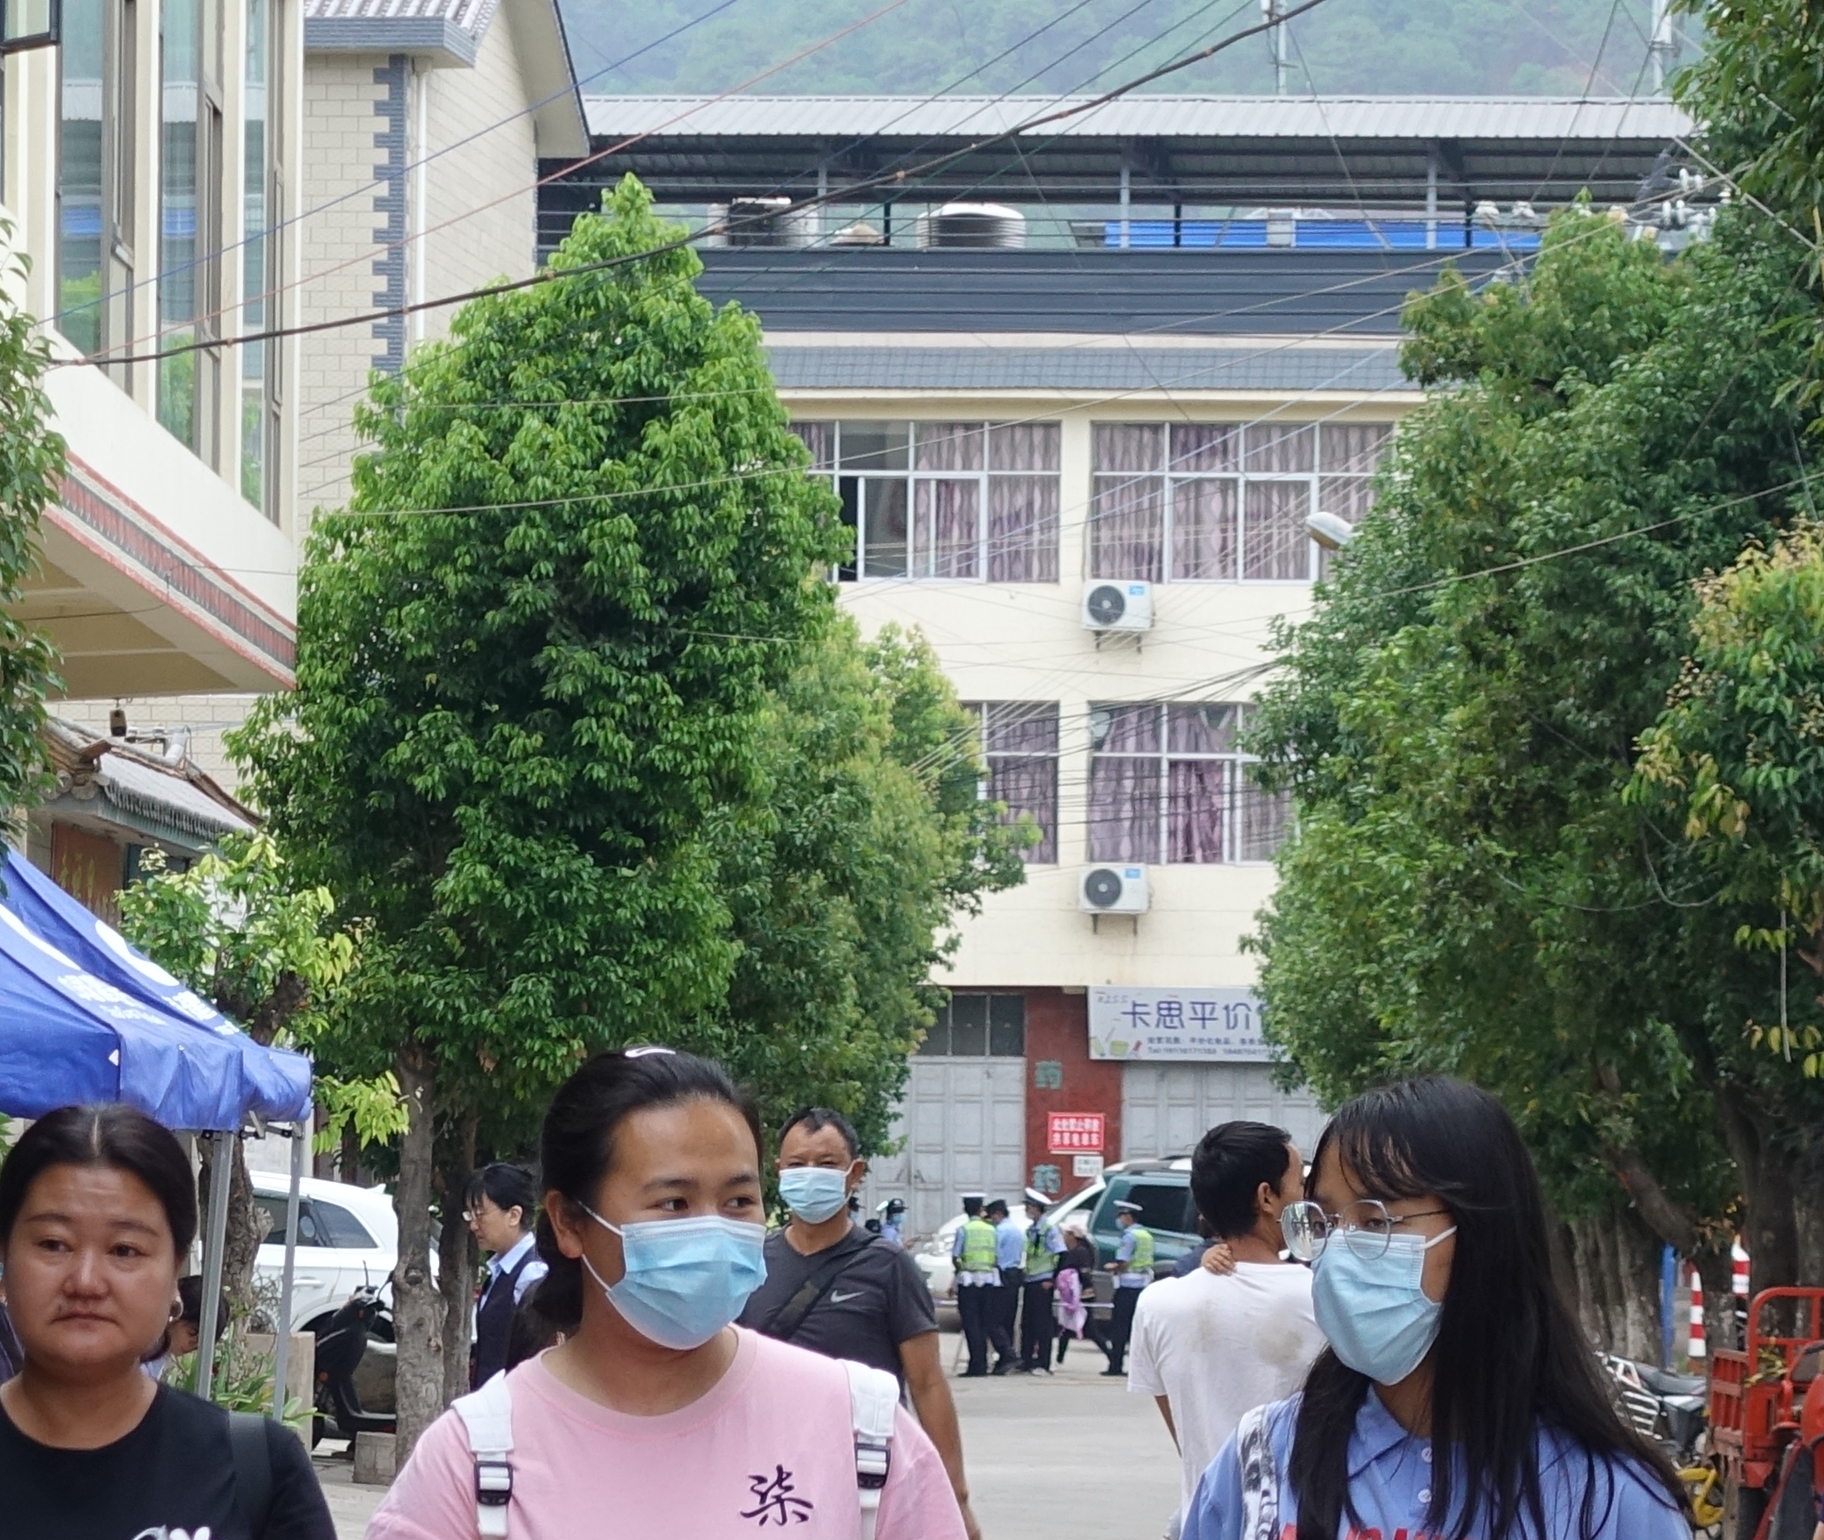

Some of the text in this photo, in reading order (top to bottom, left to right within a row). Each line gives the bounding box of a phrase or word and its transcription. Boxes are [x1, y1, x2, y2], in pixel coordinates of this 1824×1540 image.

[1120, 1000, 1266, 1031] 卡思平价
[739, 1464, 814, 1527] 柒
